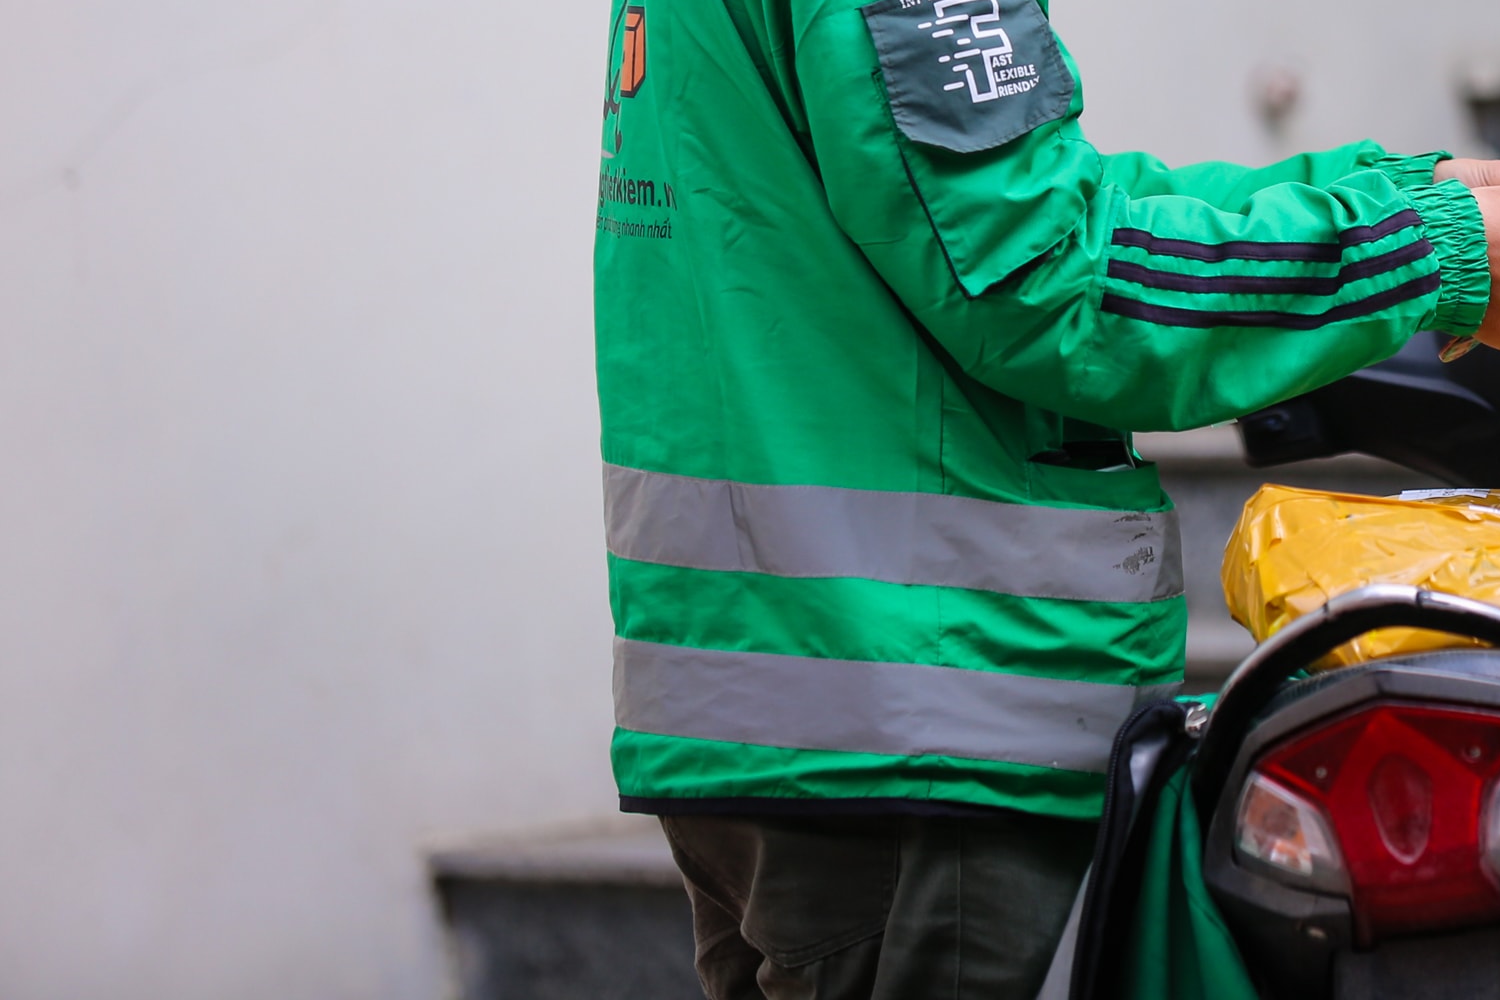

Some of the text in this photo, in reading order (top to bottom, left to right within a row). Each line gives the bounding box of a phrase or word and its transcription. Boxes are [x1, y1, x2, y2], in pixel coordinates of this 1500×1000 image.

[992, 53, 1013, 68] AST
[994, 64, 1036, 82] LEXIBLE
[998, 75, 1040, 97] RIENDLY
